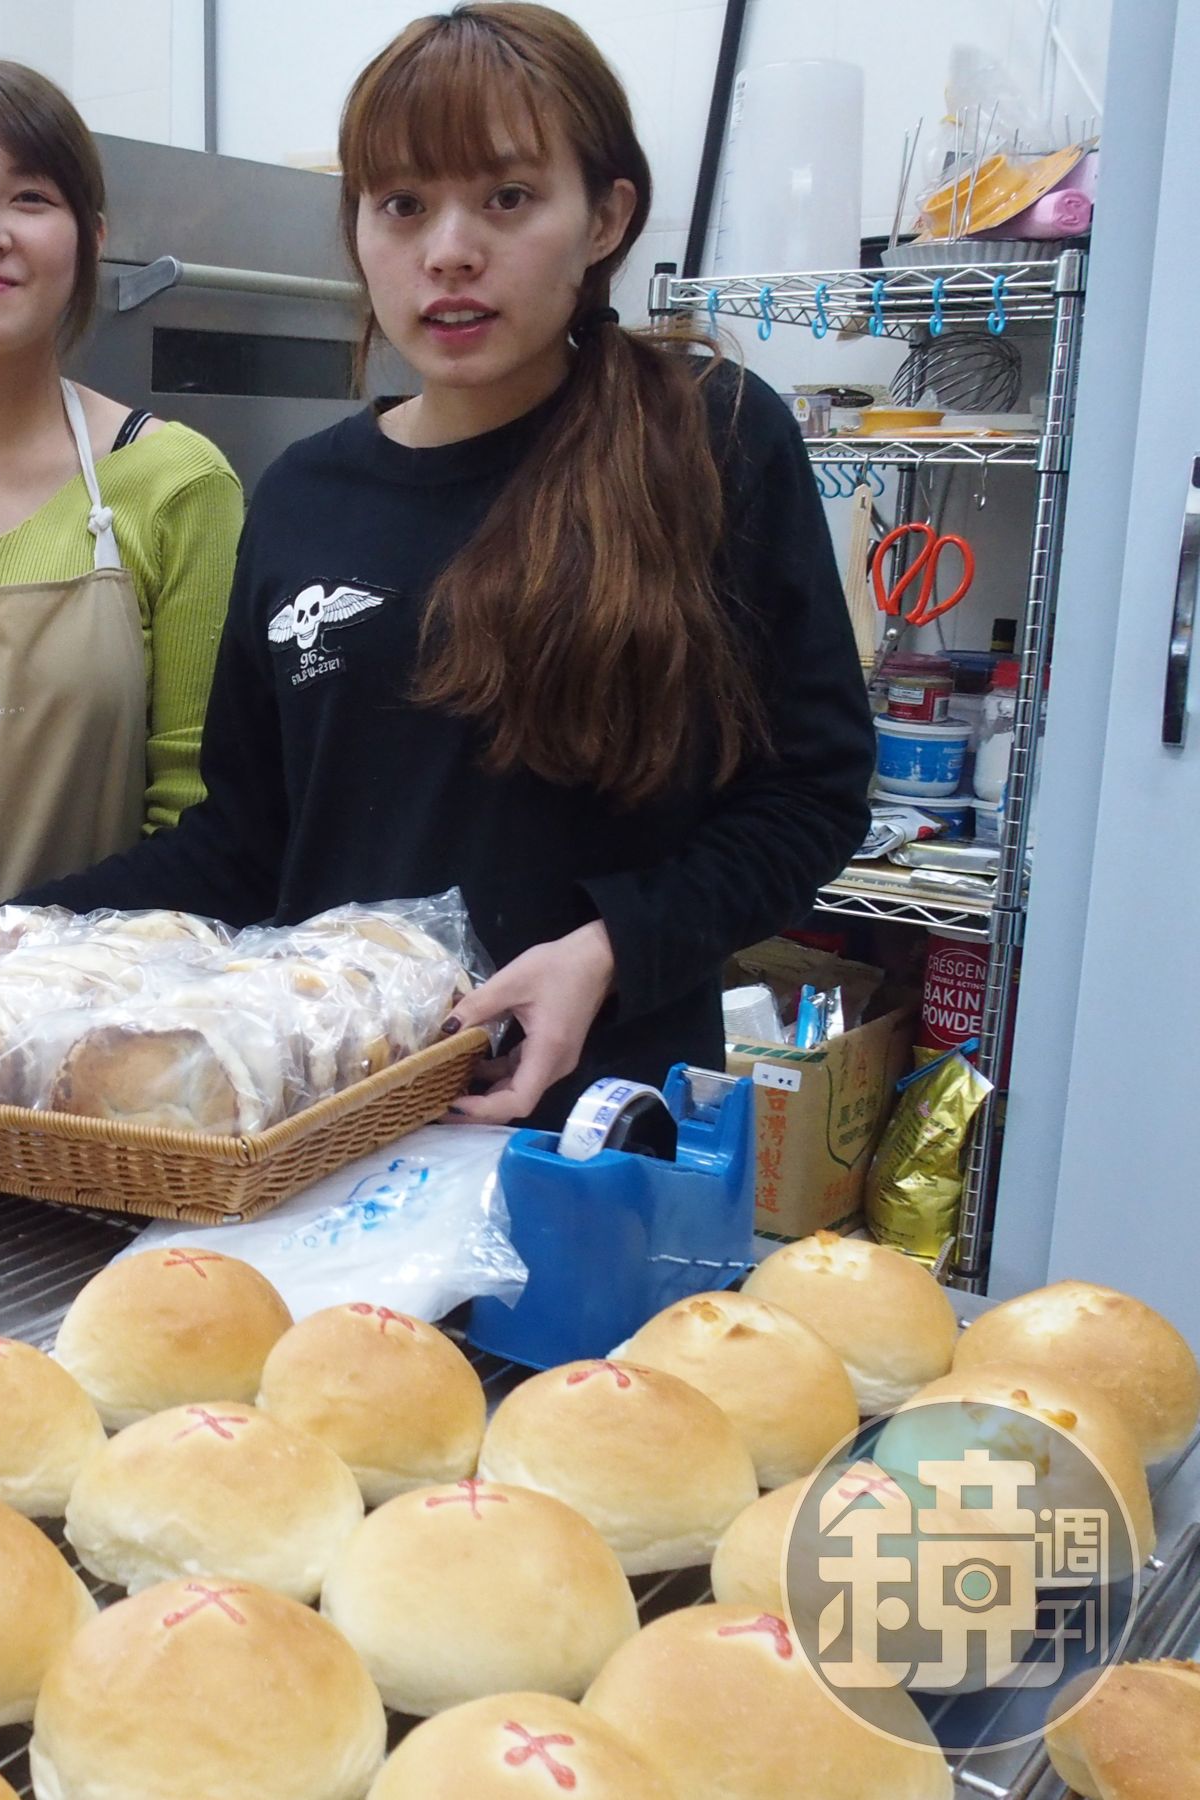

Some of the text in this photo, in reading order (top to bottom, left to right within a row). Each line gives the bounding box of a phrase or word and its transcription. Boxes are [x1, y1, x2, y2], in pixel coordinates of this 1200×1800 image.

[928, 955, 987, 980] CRESCEN
[924, 982, 980, 1011] BAKIN
[922, 1004, 982, 1034] POWDE
